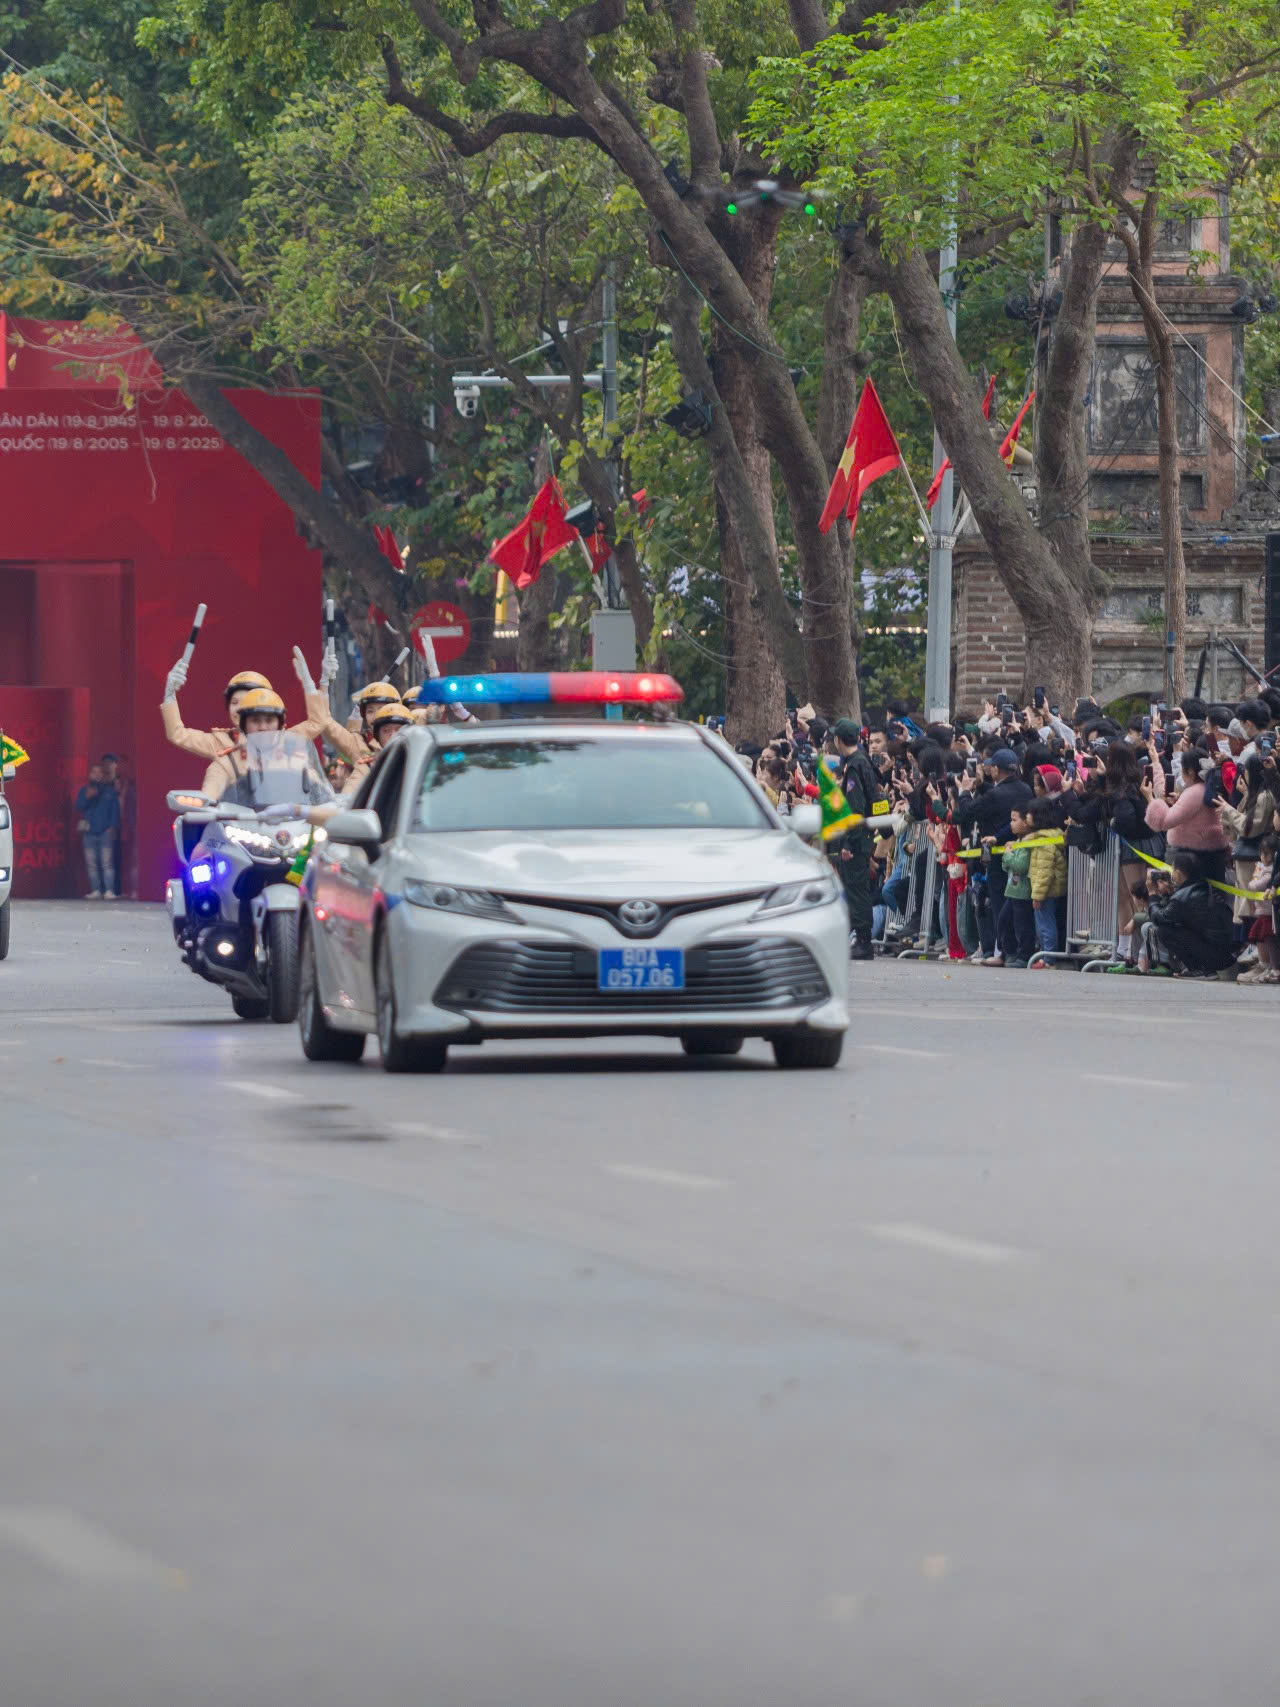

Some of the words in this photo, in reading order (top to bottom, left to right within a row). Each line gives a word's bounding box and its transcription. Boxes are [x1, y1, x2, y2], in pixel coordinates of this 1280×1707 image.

[26, 412, 60, 428] DÂN
[0, 433, 45, 451] QUỐC
[622, 948, 659, 967] 80A
